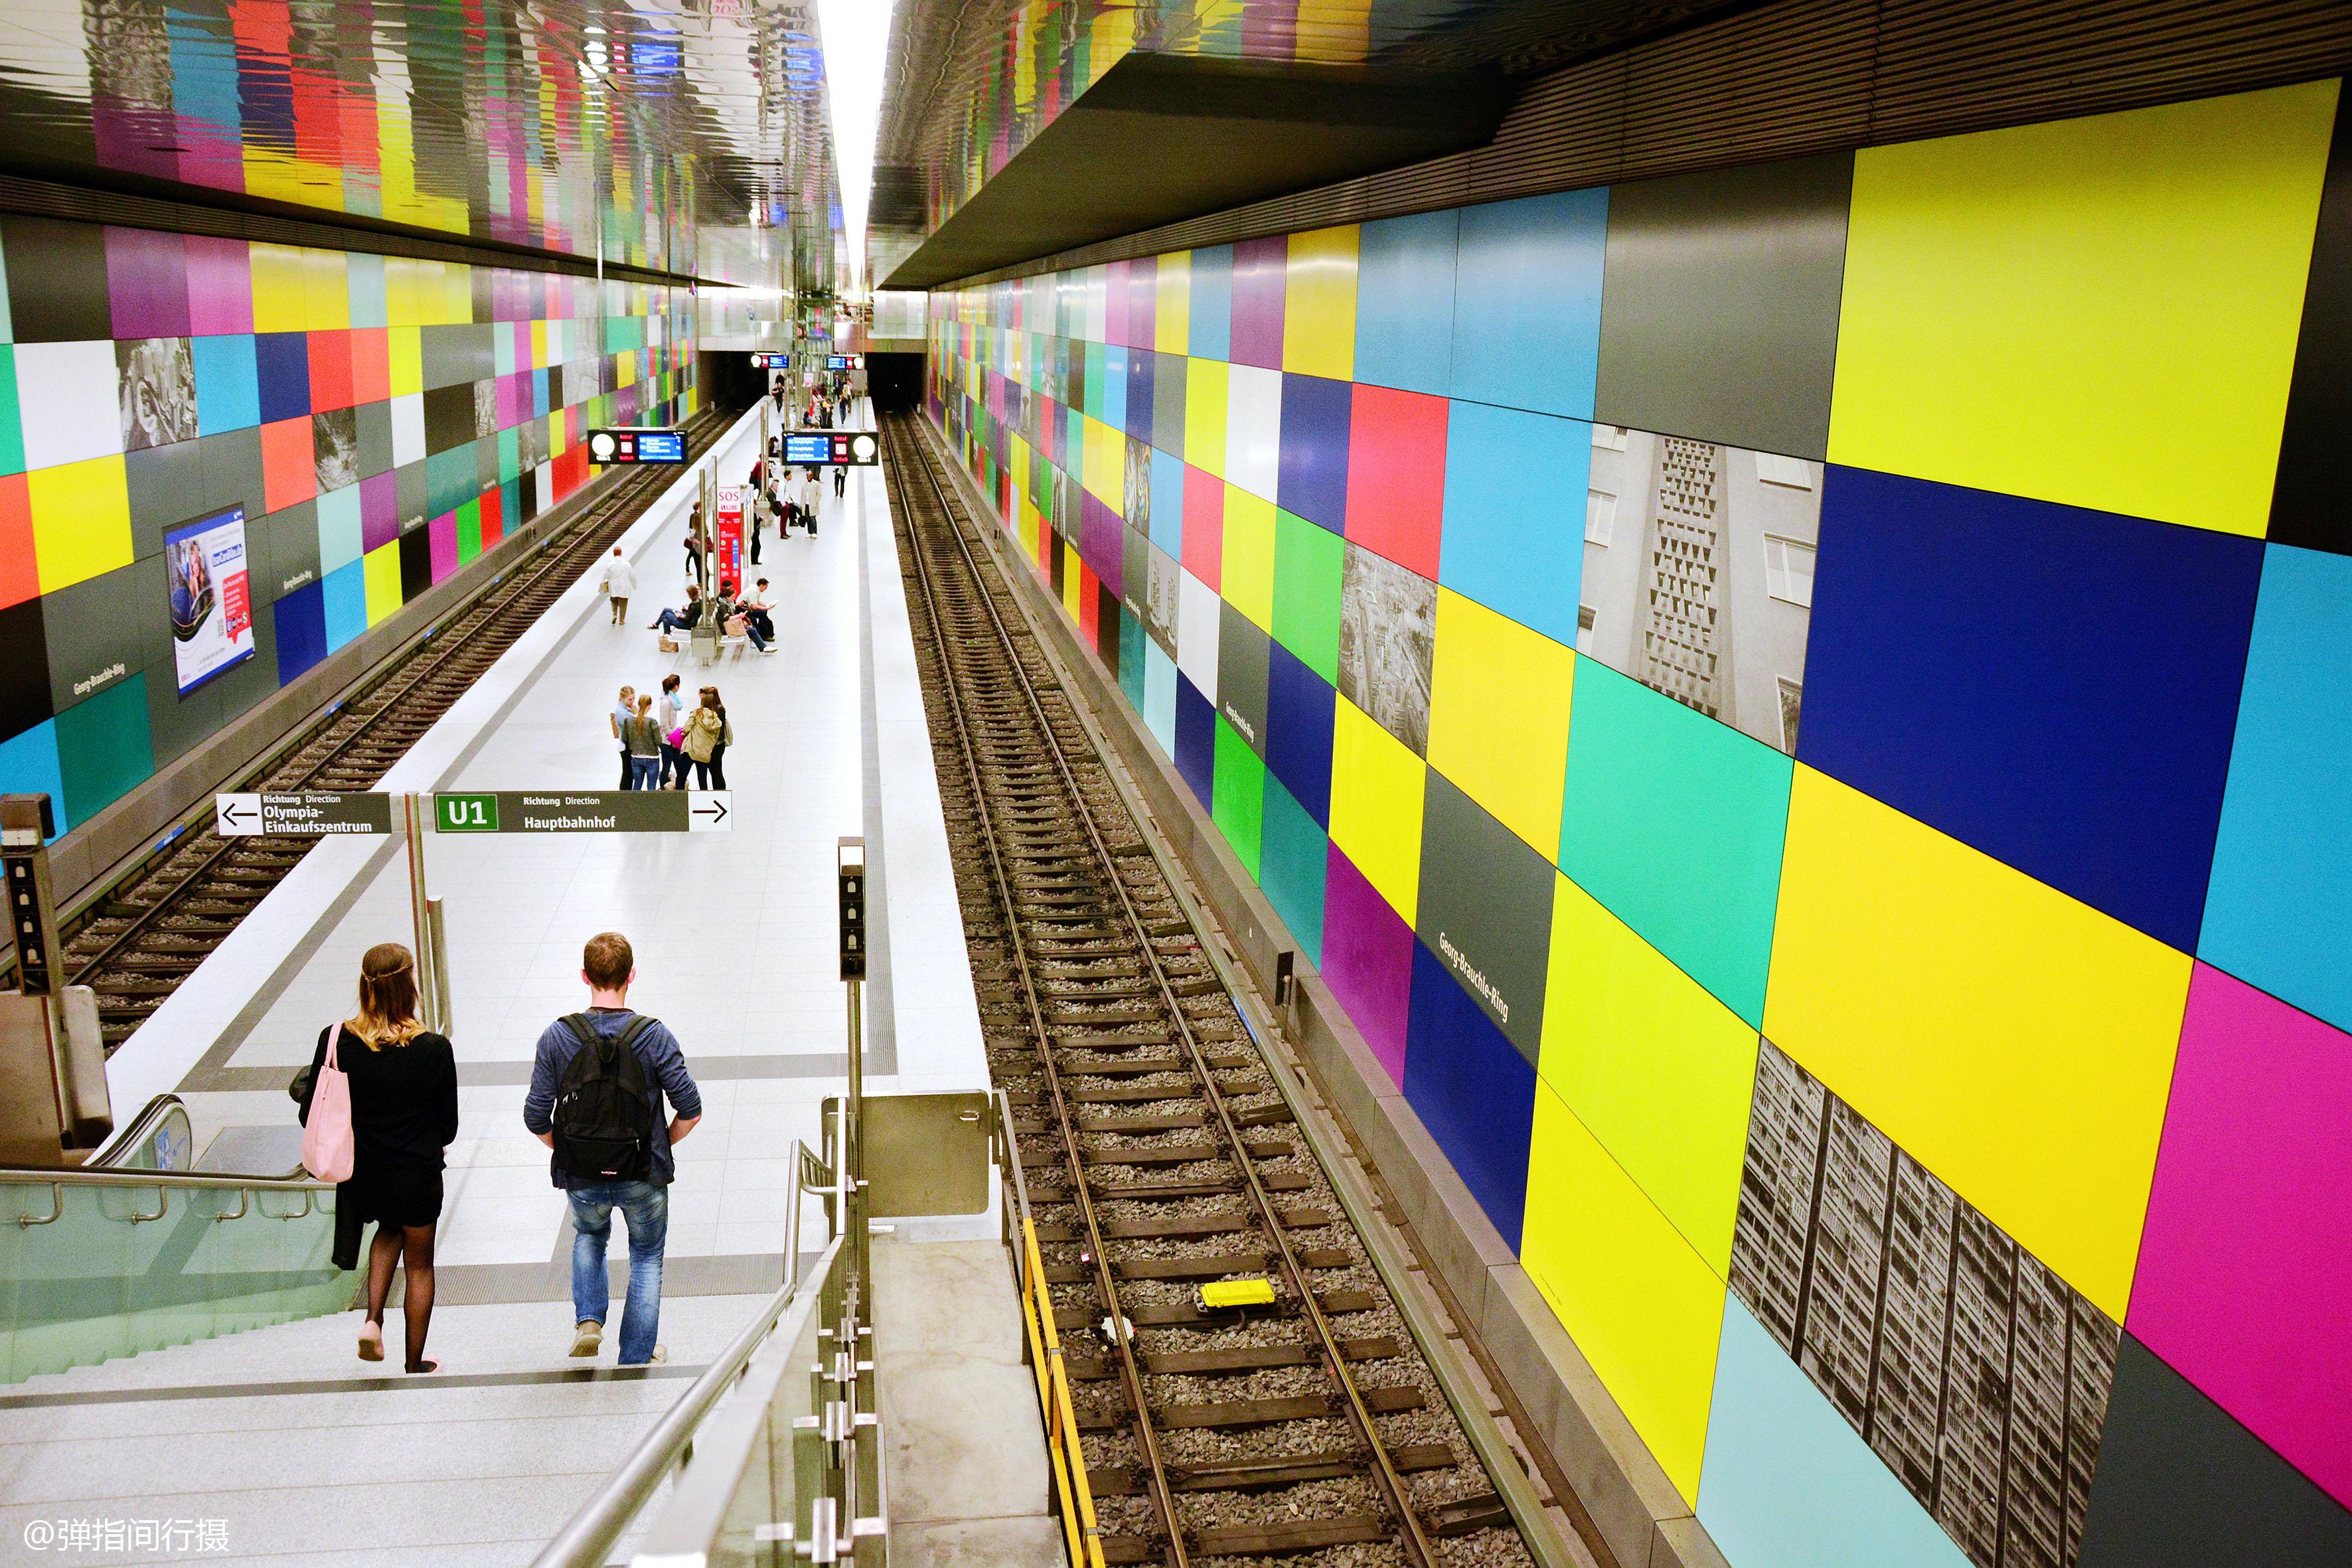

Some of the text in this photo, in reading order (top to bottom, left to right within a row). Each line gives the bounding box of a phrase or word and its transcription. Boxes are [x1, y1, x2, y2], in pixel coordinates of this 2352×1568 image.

[718, 491, 739, 501] SOS
[74, 663, 125, 695] Georg-Brauchle-Ring
[263, 795, 341, 805] Richtung Direction
[523, 797, 600, 807] Richtung Direction
[264, 805, 324, 821] Olympia-
[448, 801, 487, 824] U1
[265, 821, 373, 833] Einkaufszentrum
[524, 815, 616, 831] Hauptbahnhof
[1439, 931, 1509, 1024] Georg-Brauchle-Ring
